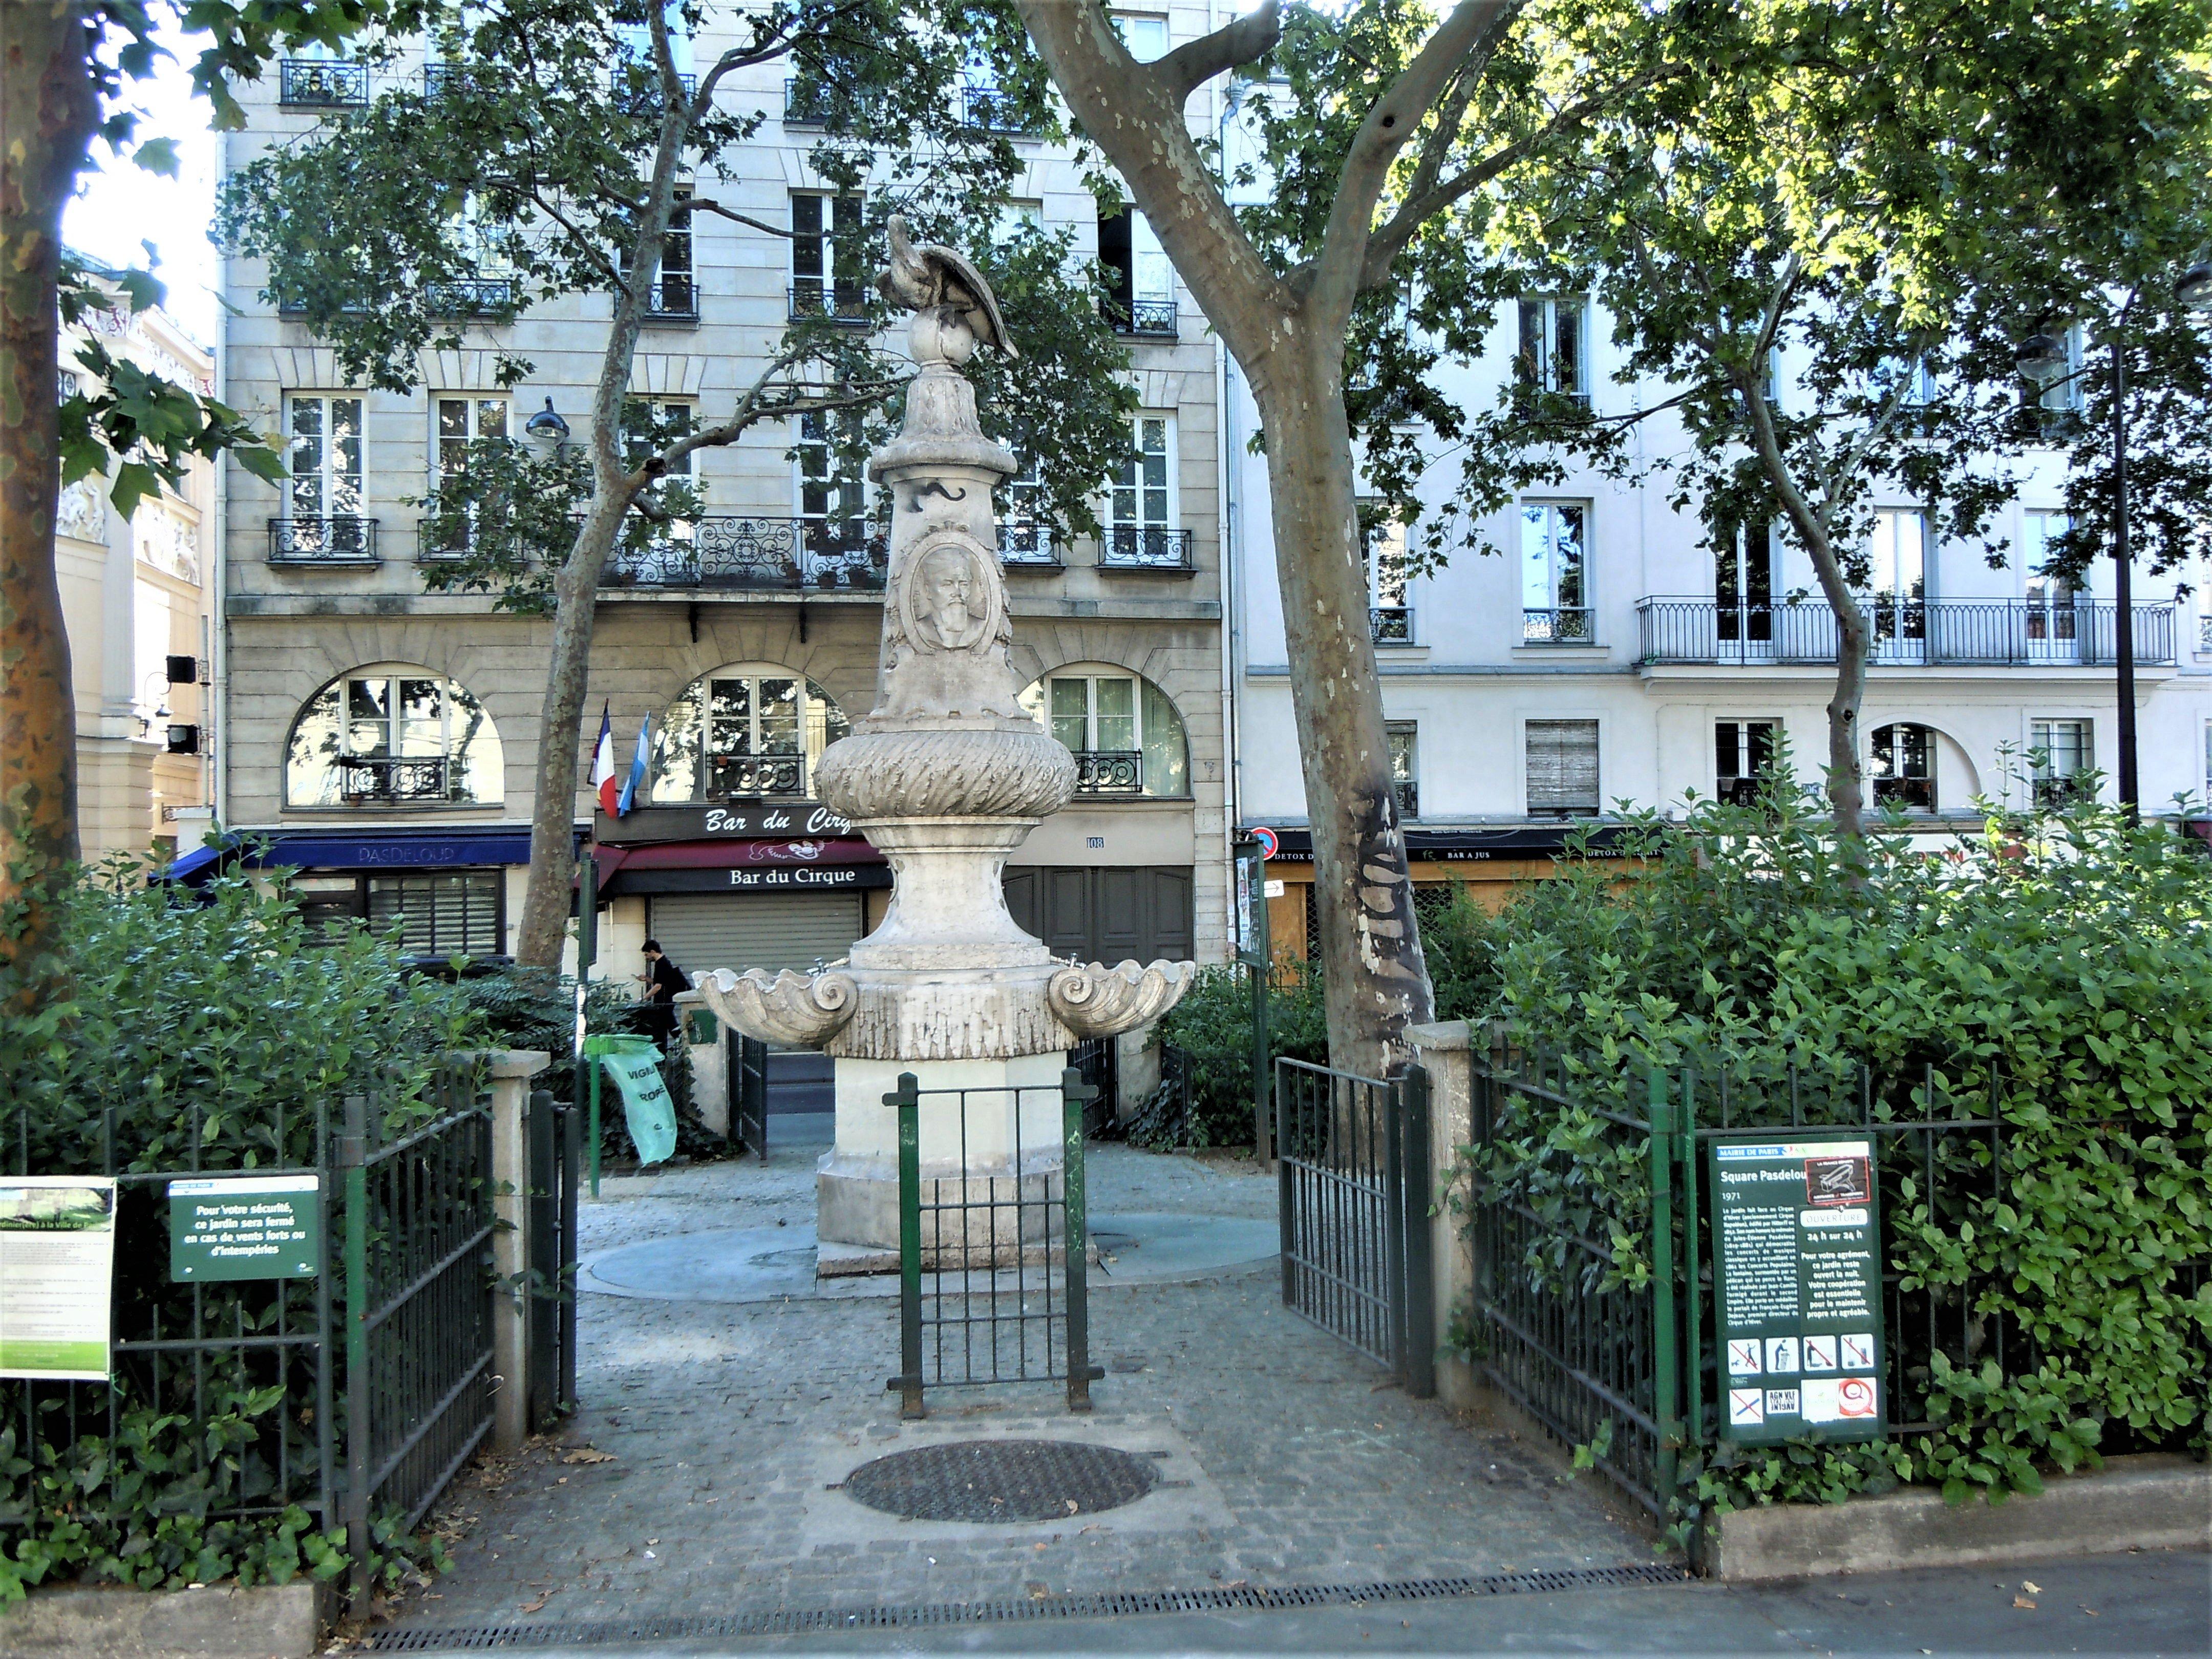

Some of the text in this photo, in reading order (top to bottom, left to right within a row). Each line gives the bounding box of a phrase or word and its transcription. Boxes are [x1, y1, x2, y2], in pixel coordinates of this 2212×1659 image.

[706, 807, 852, 835] Bar du Cirq
[1088, 839, 1102, 848] 108
[731, 868, 856, 885] Bar du Cirque
[1720, 1169, 1807, 1184] Square Pasdelou
[197, 1203, 293, 1216] Pour votre sécurité,
[209, 1219, 238, 1230] jardin
[241, 1219, 263, 1228] sera
[266, 1216, 294, 1226] fermé
[1807, 1214, 1861, 1223] OUVERTURE
[184, 1230, 305, 1243] en cas de vents forts ou
[1807, 1233, 1818, 1242] 24
[1821, 1231, 1826, 1241] h
[1843, 1232, 1854, 1241] 24
[1857, 1230, 1862, 1239] h
[1837, 1250, 1870, 1260] agrément,
[1822, 1262, 1841, 1270] jardin
[1828, 1279, 1866, 1289] coopération
[1826, 1289, 1861, 1298] essentielle
[1810, 1301, 1825, 1310] pour
[1807, 1310, 1828, 1320] propre
[1839, 1308, 1870, 1318] agréable.
